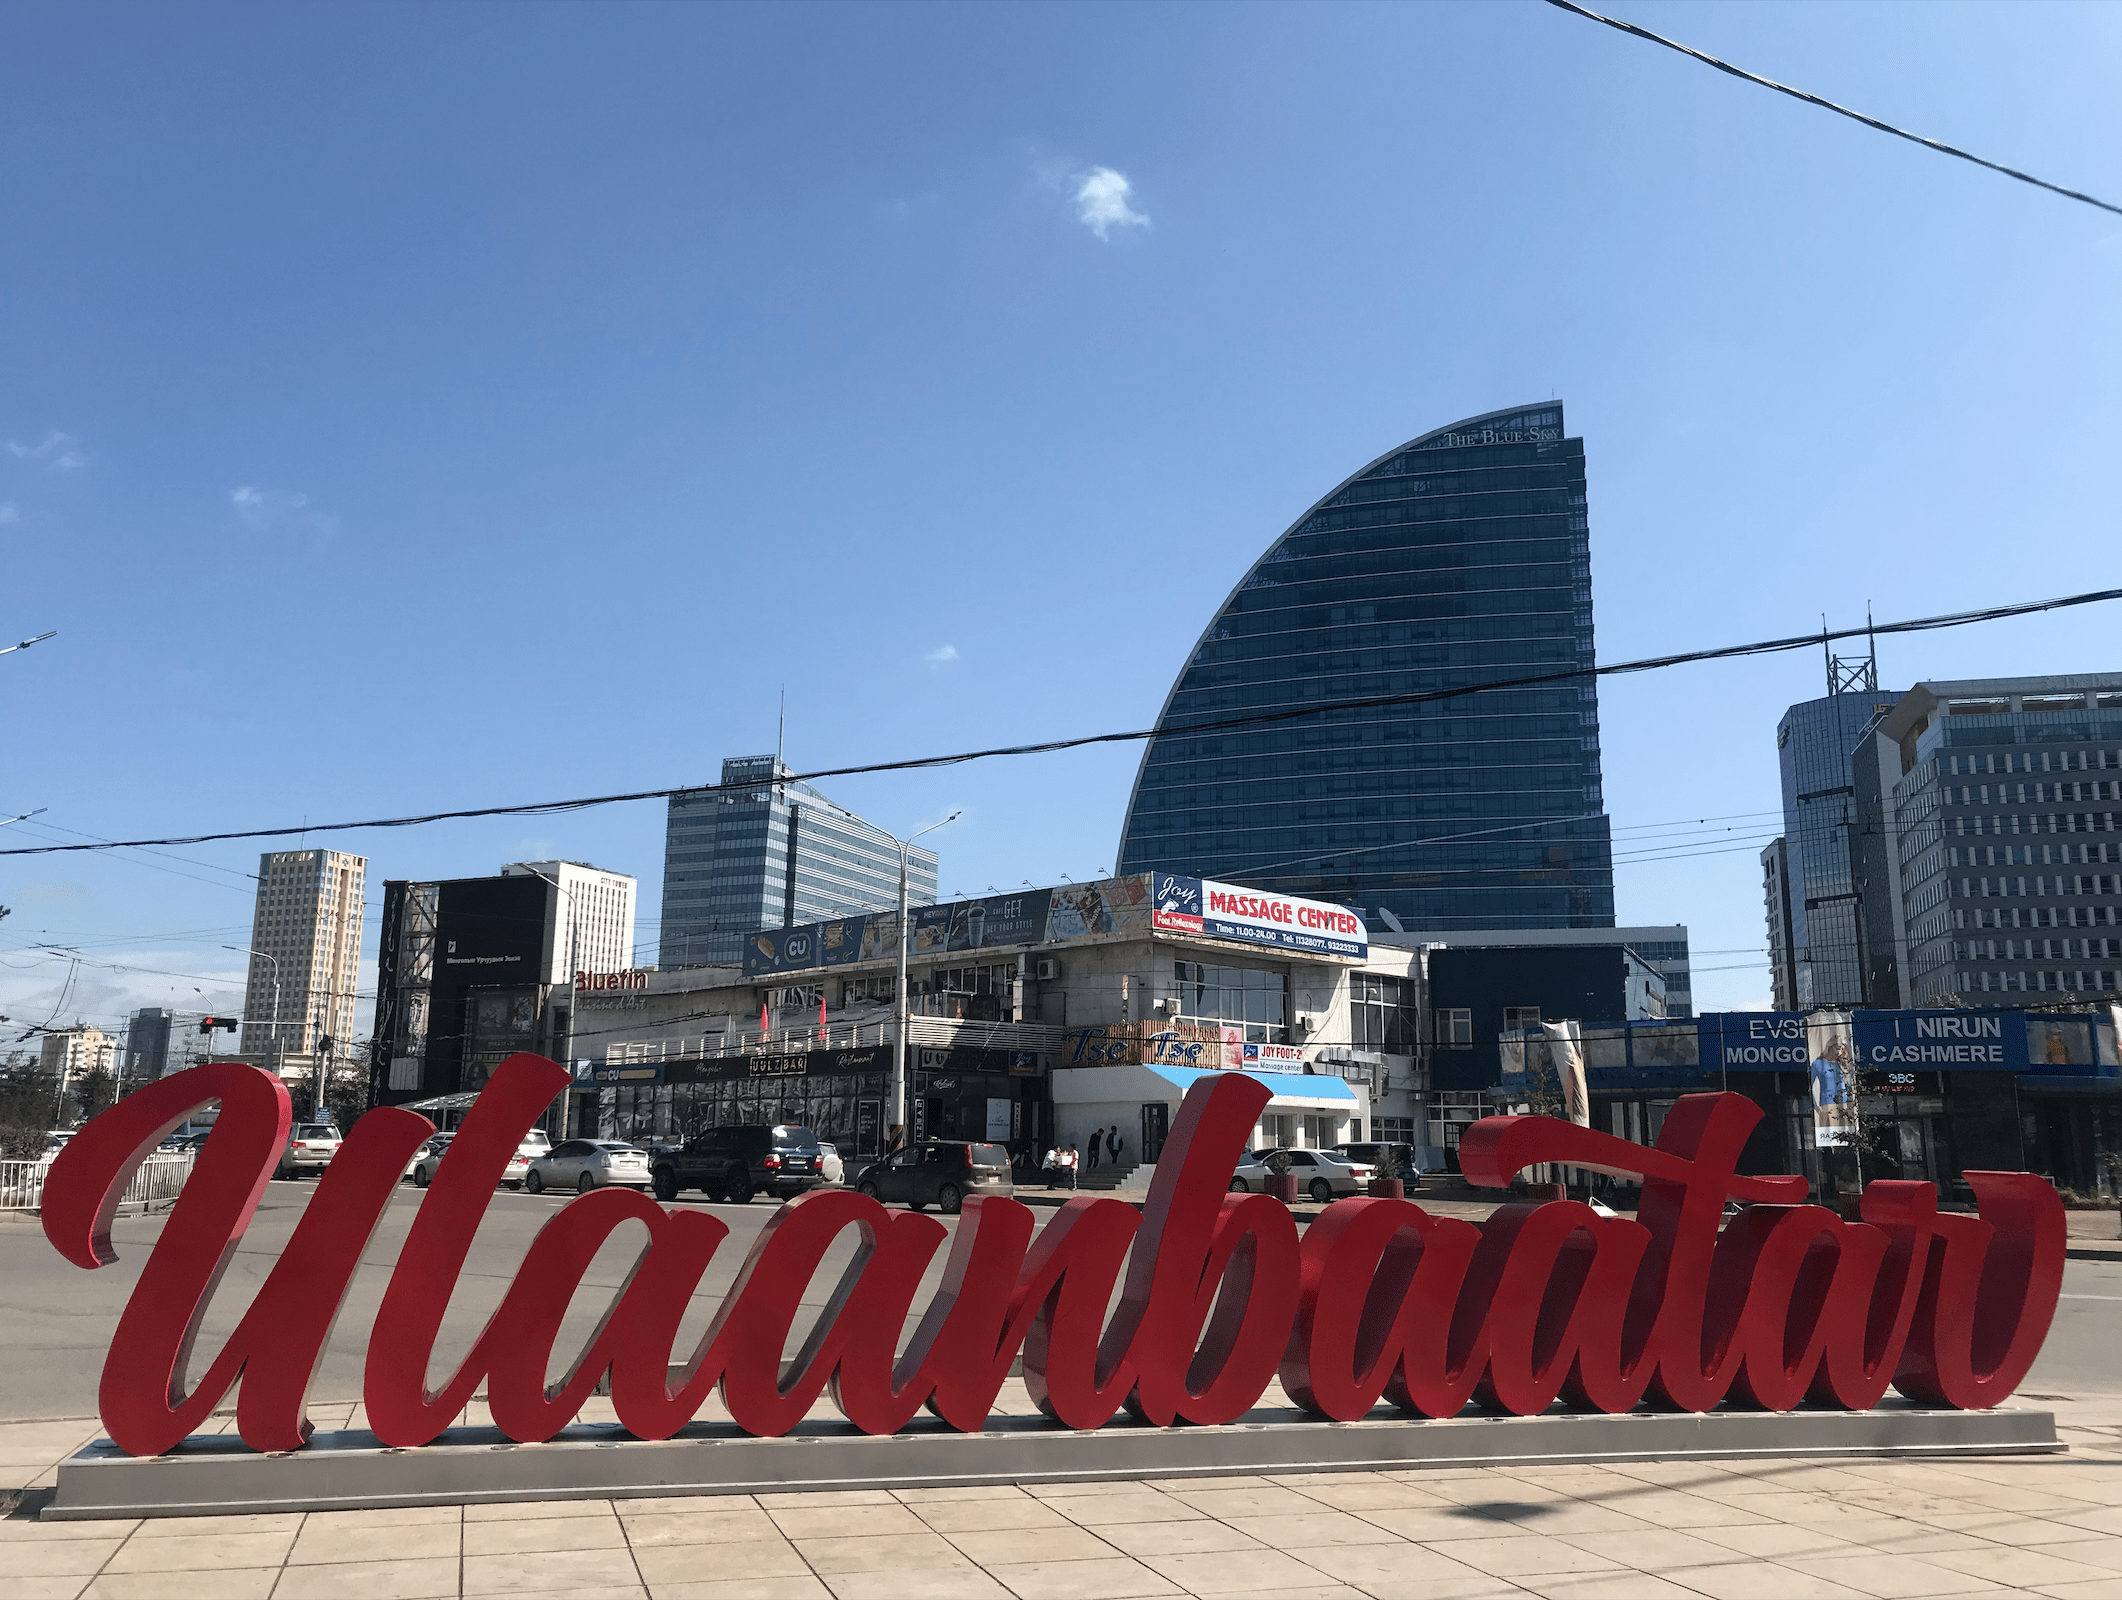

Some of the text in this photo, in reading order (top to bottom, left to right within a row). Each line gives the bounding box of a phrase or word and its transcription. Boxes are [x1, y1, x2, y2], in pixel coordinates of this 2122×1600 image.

[1157, 876, 1198, 905] Joy
[1003, 898, 1023, 919] GET
[1210, 890, 1358, 935] MASSAGE CENTER
[1157, 914, 1172, 926] Foot
[788, 939, 807, 957] CU
[1215, 923, 1235, 934] Time:
[1236, 926, 1277, 941] 11.00-24.00
[1327, 940, 1360, 954] 93223333
[575, 967, 648, 992] Bluefin
[1916, 1016, 2002, 1039] NIRUN
[1061, 1027, 1129, 1064] Tse
[1149, 1030, 1204, 1060] Tse
[1261, 1045, 1275, 1058] JOY
[1871, 1044, 2004, 1063] CASHMERE
[783, 1054, 804, 1070] BAR
[1259, 1061, 1283, 1071] Massage
[608, 1070, 619, 1081] CU
[41, 1053, 2067, 1456] Ulaanbaatar
